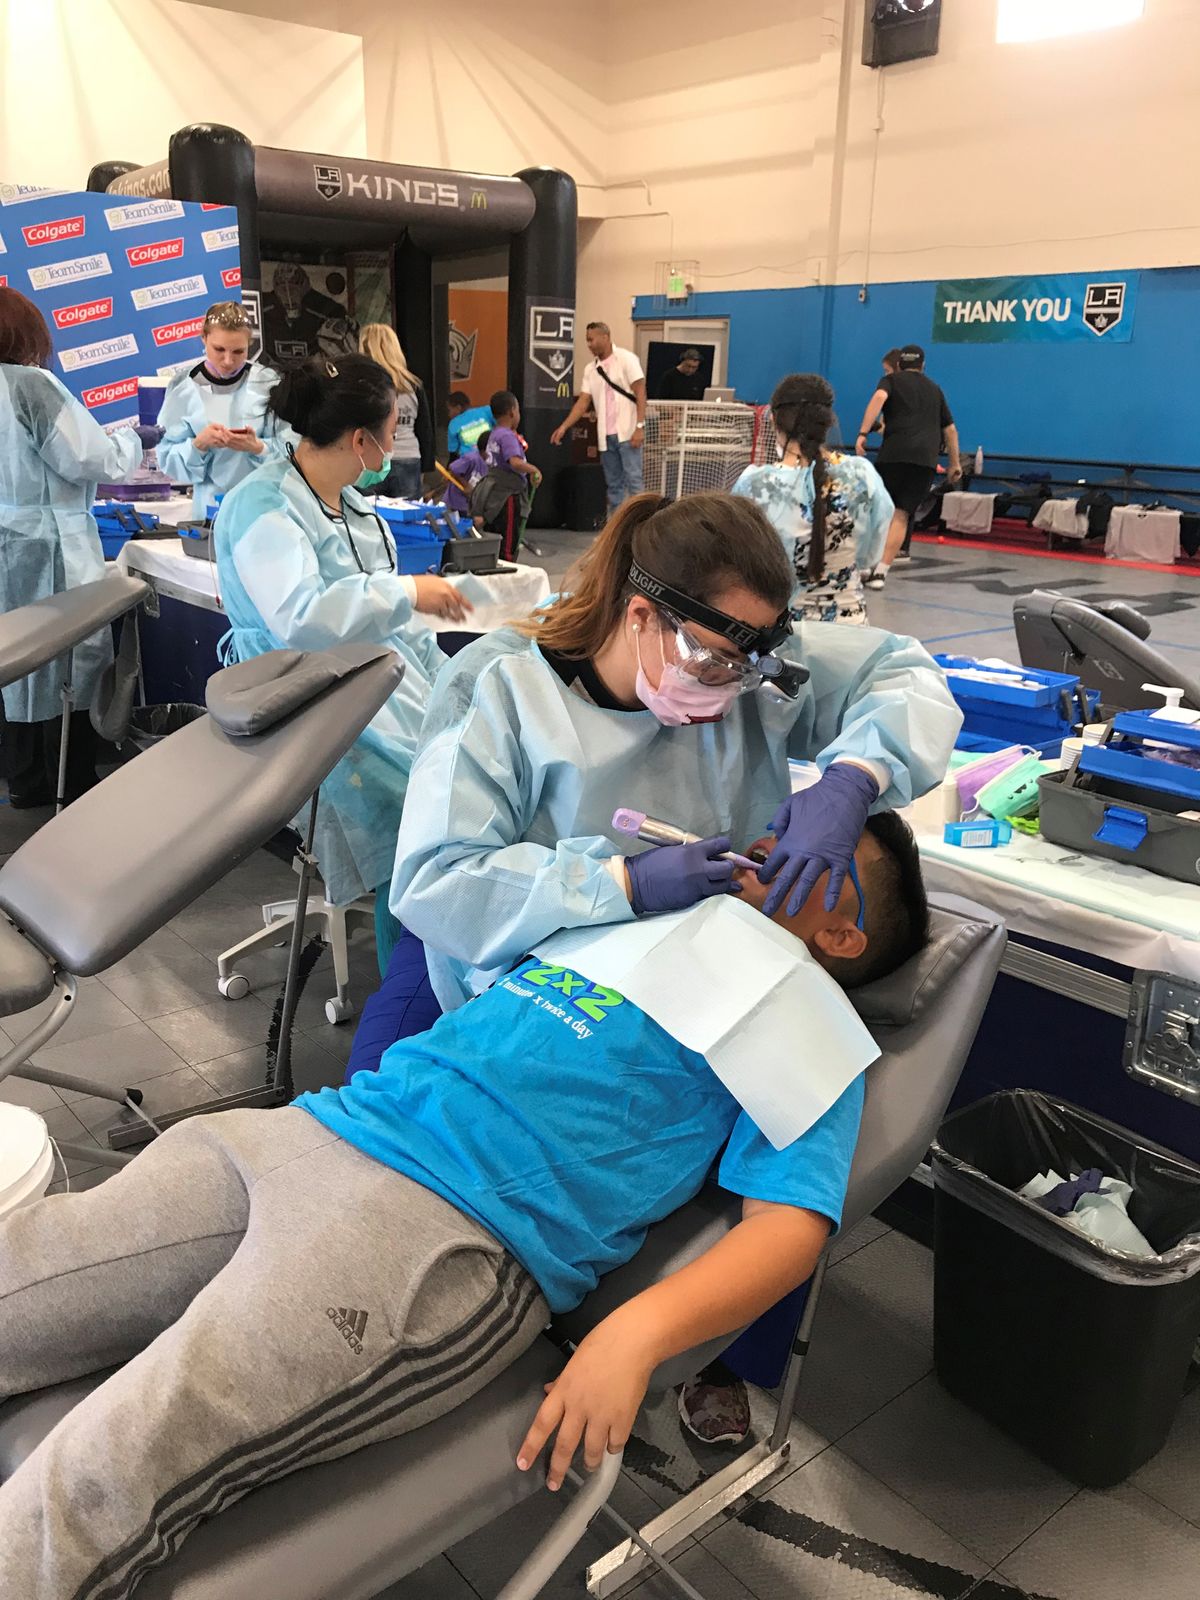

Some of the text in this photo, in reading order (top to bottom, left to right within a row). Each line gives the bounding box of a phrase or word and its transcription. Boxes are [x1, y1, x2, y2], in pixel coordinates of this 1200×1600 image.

[316, 167, 459, 208] LA KINGS
[122, 201, 177, 221] TeamSmile
[27, 221, 81, 241] Colgate
[130, 243, 179, 262] Colgate
[47, 257, 103, 280] TeamSmile
[147, 278, 200, 301] TeamSmile
[1086, 288, 1122, 306] LA
[57, 302, 109, 323] Colgate
[943, 297, 1072, 324] THANK YOU
[155, 321, 204, 341] Colgate
[535, 314, 574, 339] LA
[75, 338, 131, 361] TeamSmile
[86, 381, 135, 403] Colgate
[629, 564, 666, 597] DLIGHT
[532, 994, 544, 1005] x
[541, 1000, 566, 1018] twice
[563, 1015, 574, 1025] a
[571, 1019, 594, 1040] day
[326, 1306, 364, 1356] adidas
